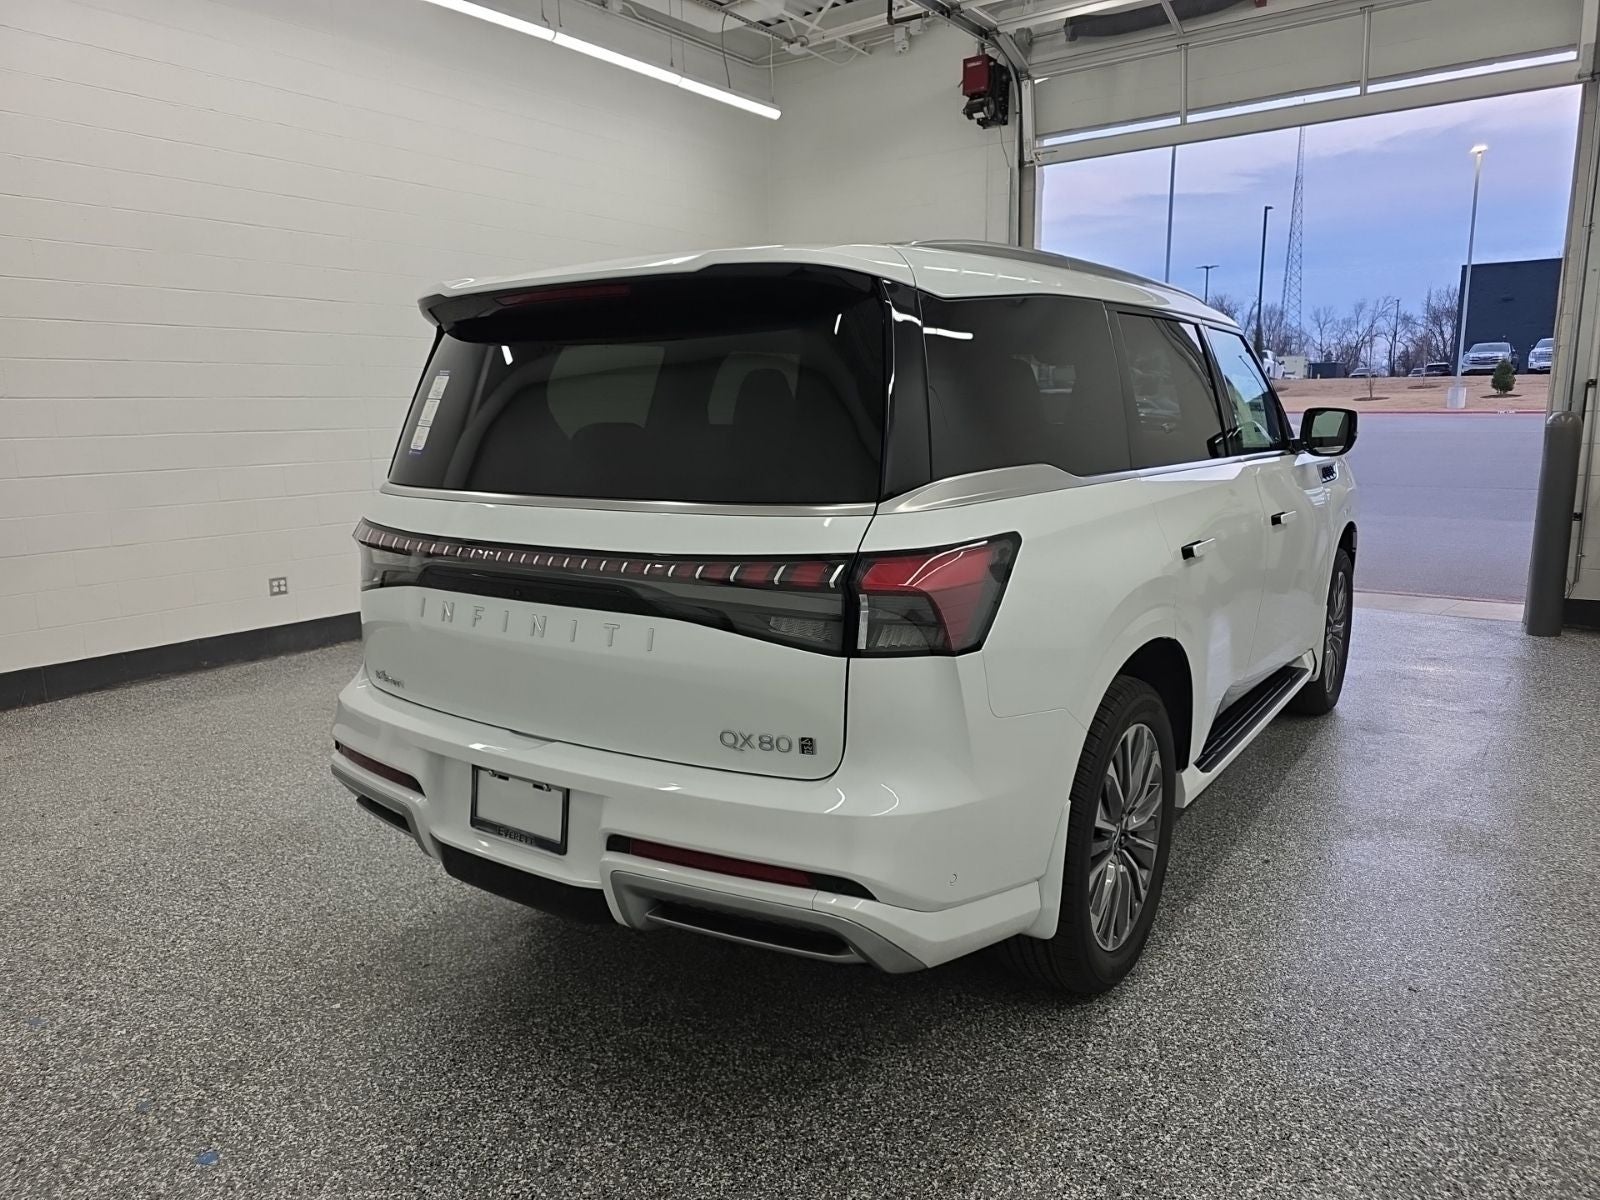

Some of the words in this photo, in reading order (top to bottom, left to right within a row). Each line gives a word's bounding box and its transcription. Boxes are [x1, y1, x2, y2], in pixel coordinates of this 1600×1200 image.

[421, 597, 655, 652] INFINITI
[719, 729, 793, 753] QX80
[497, 825, 535, 846] EVERETT
